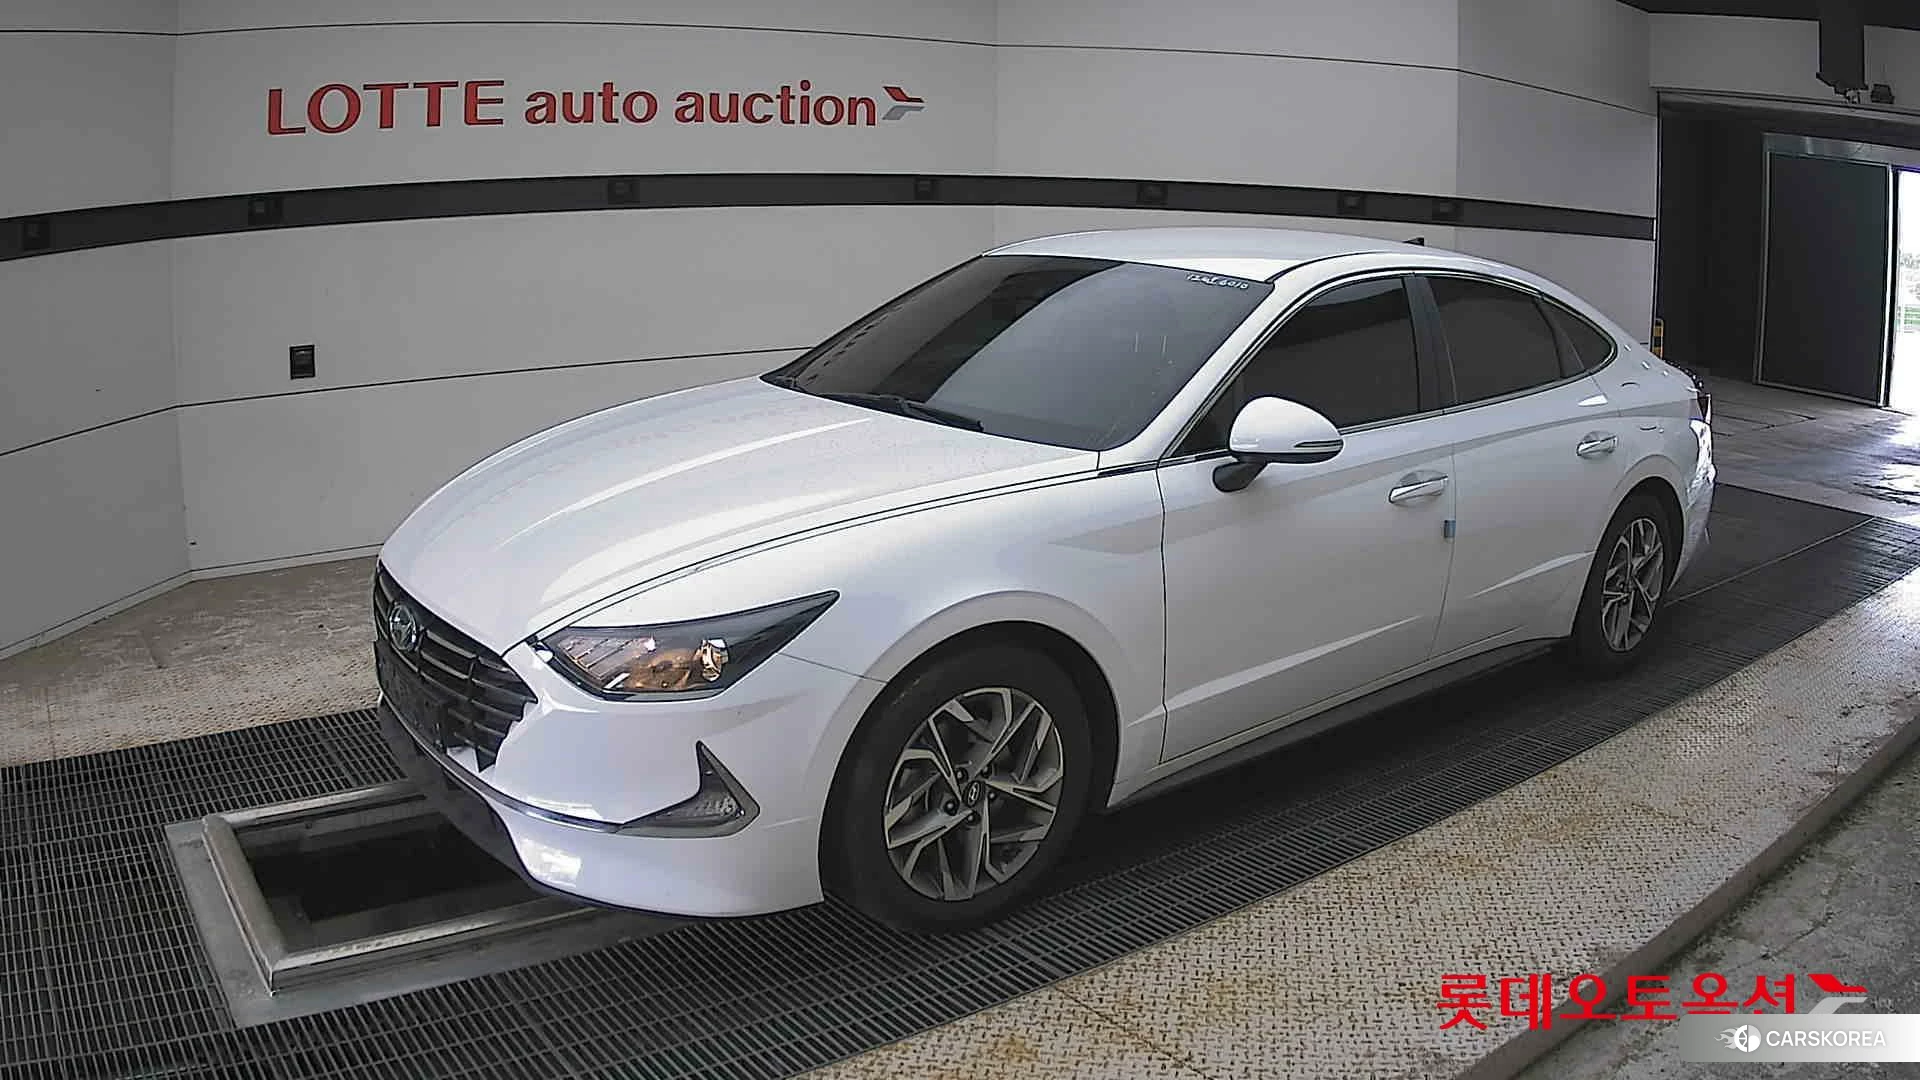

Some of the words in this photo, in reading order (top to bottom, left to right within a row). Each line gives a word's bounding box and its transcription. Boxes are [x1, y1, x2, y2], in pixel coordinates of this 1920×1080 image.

[268, 80, 504, 135] LOTTE
[525, 82, 658, 125] auto
[674, 80, 876, 126] auction
